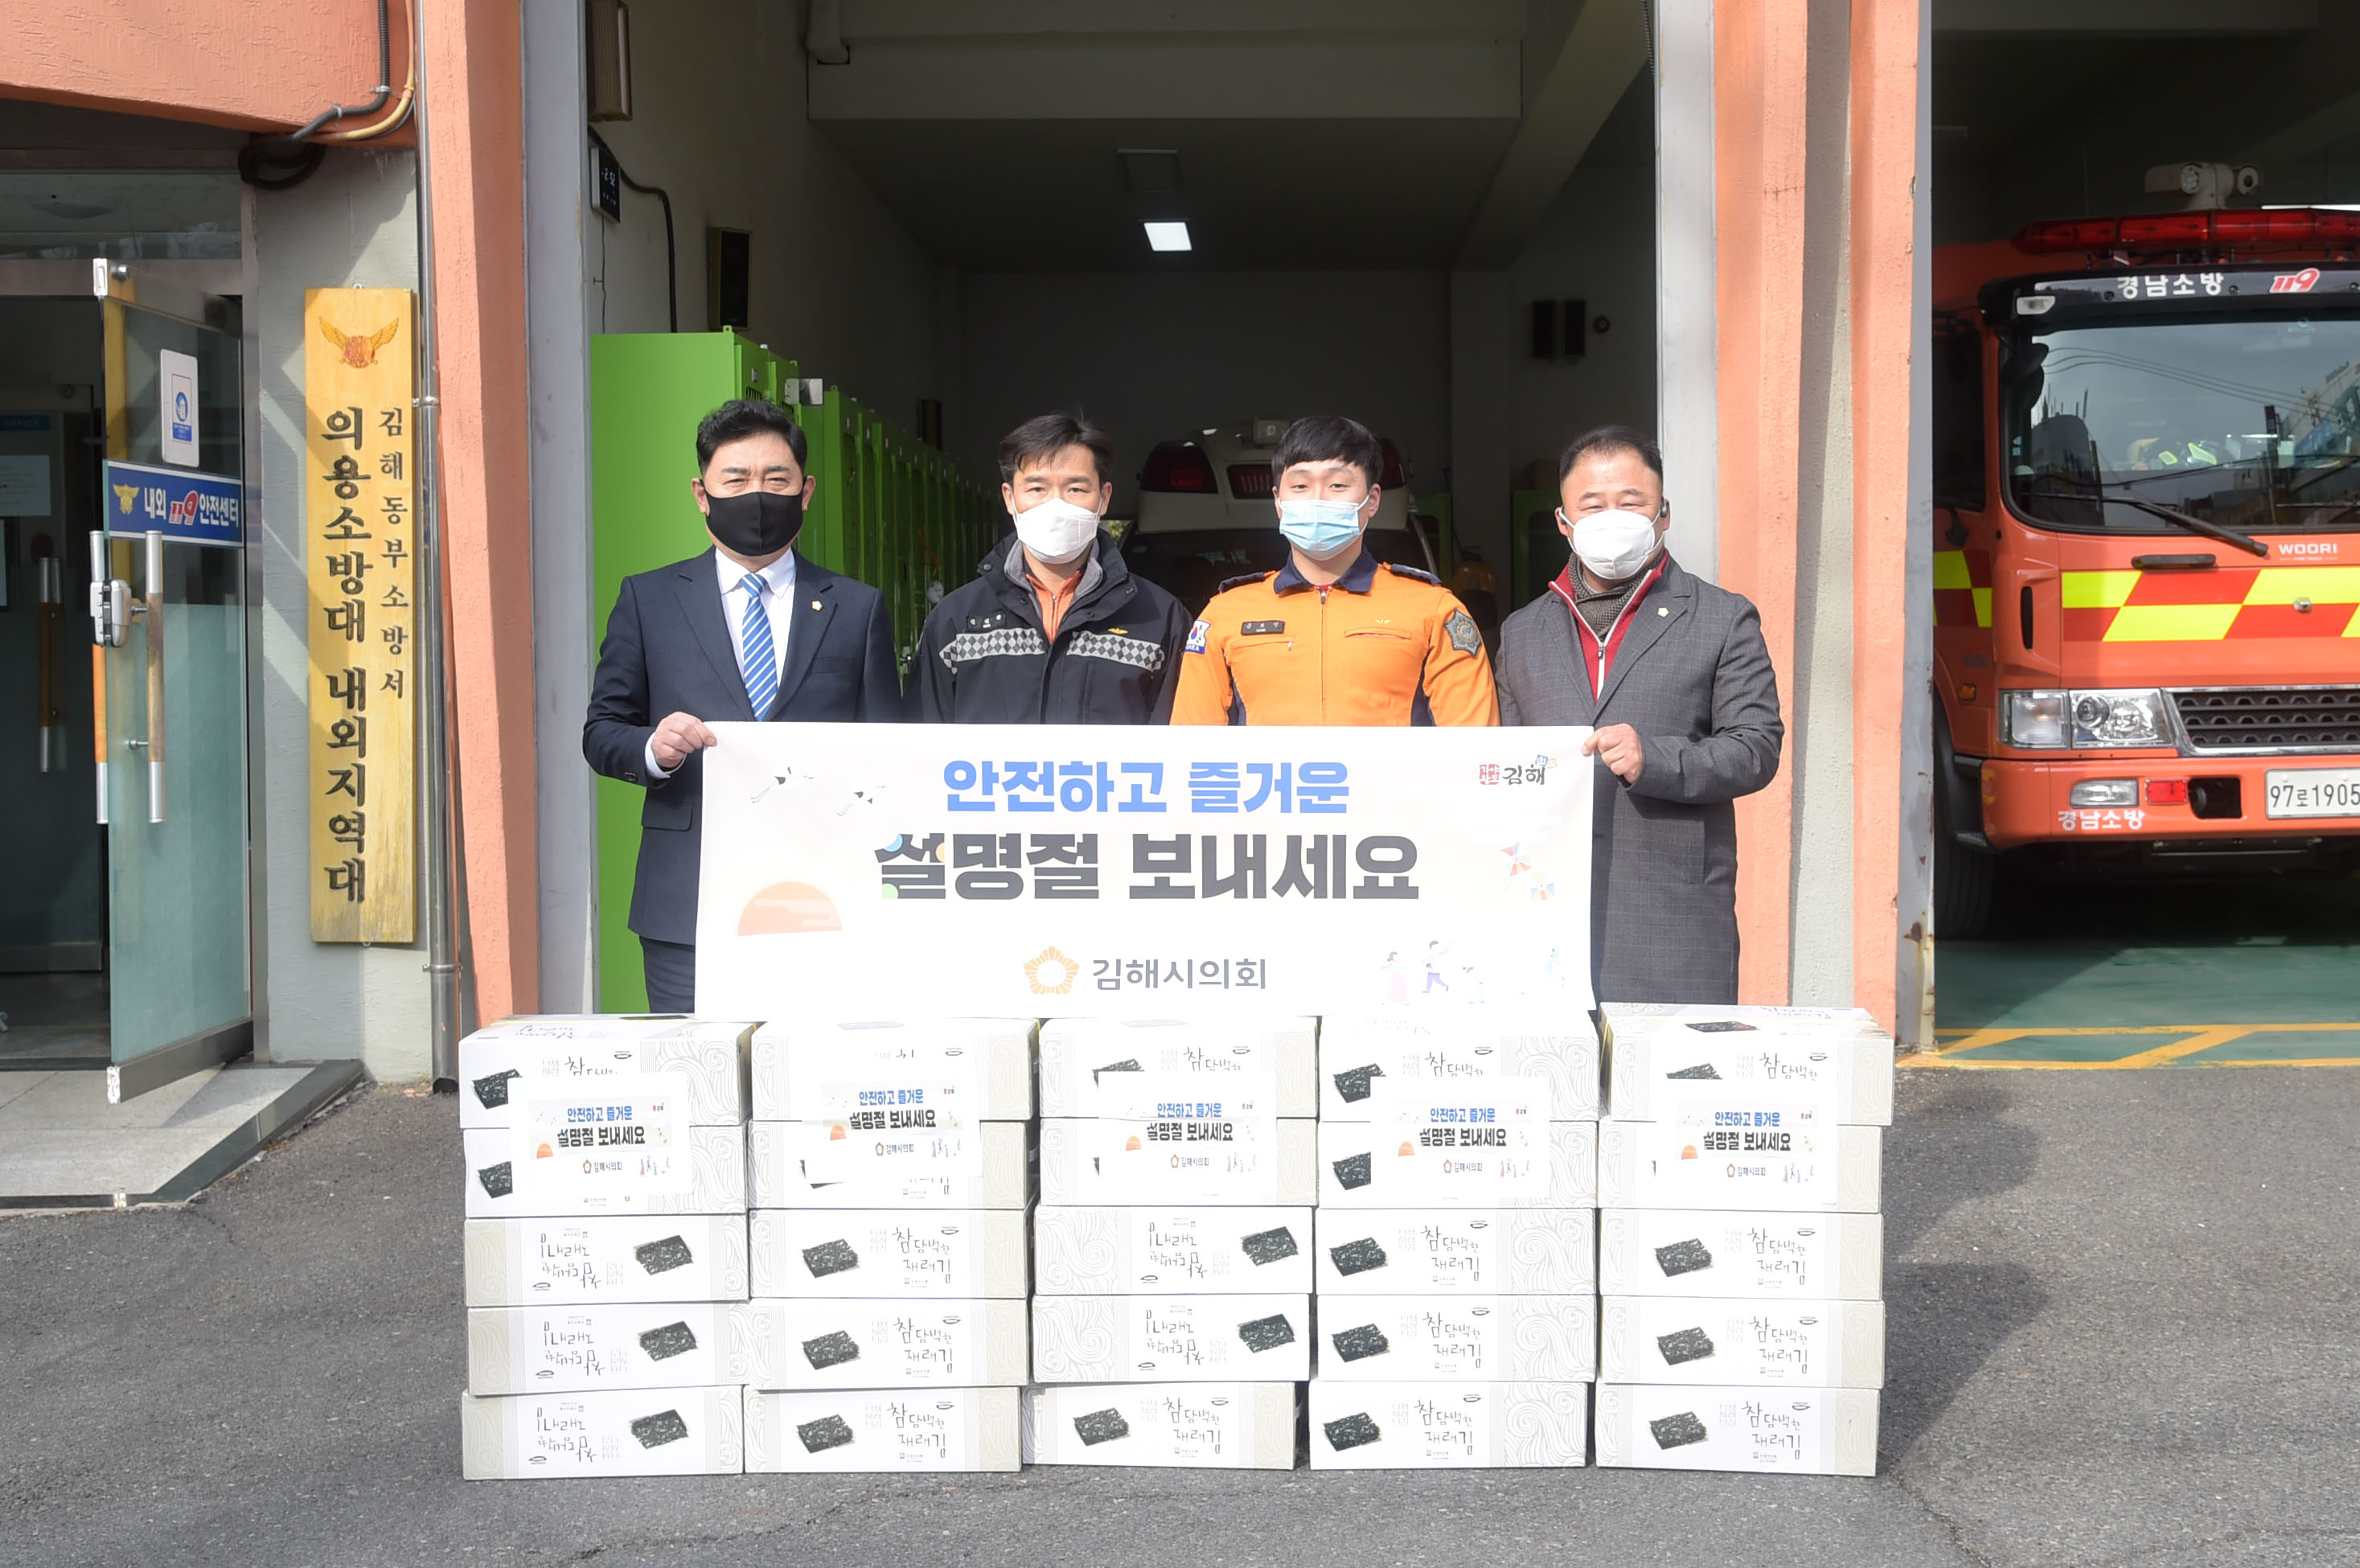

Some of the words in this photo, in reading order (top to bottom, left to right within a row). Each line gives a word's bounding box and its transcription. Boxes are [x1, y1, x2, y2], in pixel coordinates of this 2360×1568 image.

[2117, 273, 2224, 299] 경남소방
[2269, 268, 2321, 293] 119
[144, 487, 166, 520] 내외
[169, 491, 199, 526] 119
[199, 494, 239, 527] 안전센터
[322, 406, 374, 642] 의용소방대
[379, 407, 408, 699] 김해동부소방서
[2278, 543, 2337, 556] WOORI
[324, 667, 367, 903] 내외지역대
[1502, 763, 1545, 785] 김해
[944, 760, 1167, 813] 안전하고
[1188, 761, 1349, 814] 즐거운
[2270, 783, 2360, 808] 97로1905
[2058, 809, 2145, 831] 경남소방
[874, 832, 1099, 900] 설명절
[1129, 833, 1419, 900] 보내세요
[1092, 958, 1266, 991] 김해시의회
[860, 1090, 895, 1106] 안전하고
[898, 1089, 923, 1104] 즐거운
[568, 1107, 603, 1123] 안전하고
[607, 1106, 632, 1121] 즐거운
[849, 1111, 886, 1130] 설명절
[890, 1110, 936, 1129] 보내세요
[1158, 1103, 1192, 1118] 안전하고
[1196, 1103, 1221, 1118] 즐거운
[1430, 1108, 1466, 1123] 안전하고
[1470, 1108, 1495, 1123] 즐거운
[1715, 1112, 1751, 1126] 안전하고
[1755, 1112, 1779, 1127] 즐거운
[557, 1127, 593, 1147] 설명절
[598, 1126, 645, 1146] 보내세요
[1147, 1123, 1182, 1141] 설명절
[1187, 1123, 1233, 1141] 보내세요
[1419, 1128, 1455, 1146] 설명절
[1460, 1128, 1506, 1147] 보내세요
[1704, 1131, 1739, 1150] 설명절
[1744, 1132, 1791, 1151] 보내세요
[886, 1144, 913, 1155] 김해시의회
[594, 1162, 622, 1172] 김해시의회
[1181, 1157, 1209, 1167] 김해시의회
[1455, 1163, 1482, 1172] 김해시의회
[1738, 1167, 1766, 1176] 김해시의회
[903, 1260, 950, 1284] 재래김
[1431, 1258, 1479, 1282] 재래김
[1758, 1260, 1804, 1285] 재래김
[905, 1348, 952, 1374] 재래김
[1434, 1344, 1480, 1369] 재래김
[1759, 1349, 1807, 1373] 재래김
[898, 1435, 946, 1459] 재래김
[1174, 1430, 1220, 1454] 재래김
[1425, 1431, 1472, 1455] 재래김
[1752, 1434, 1800, 1459] 재래김
